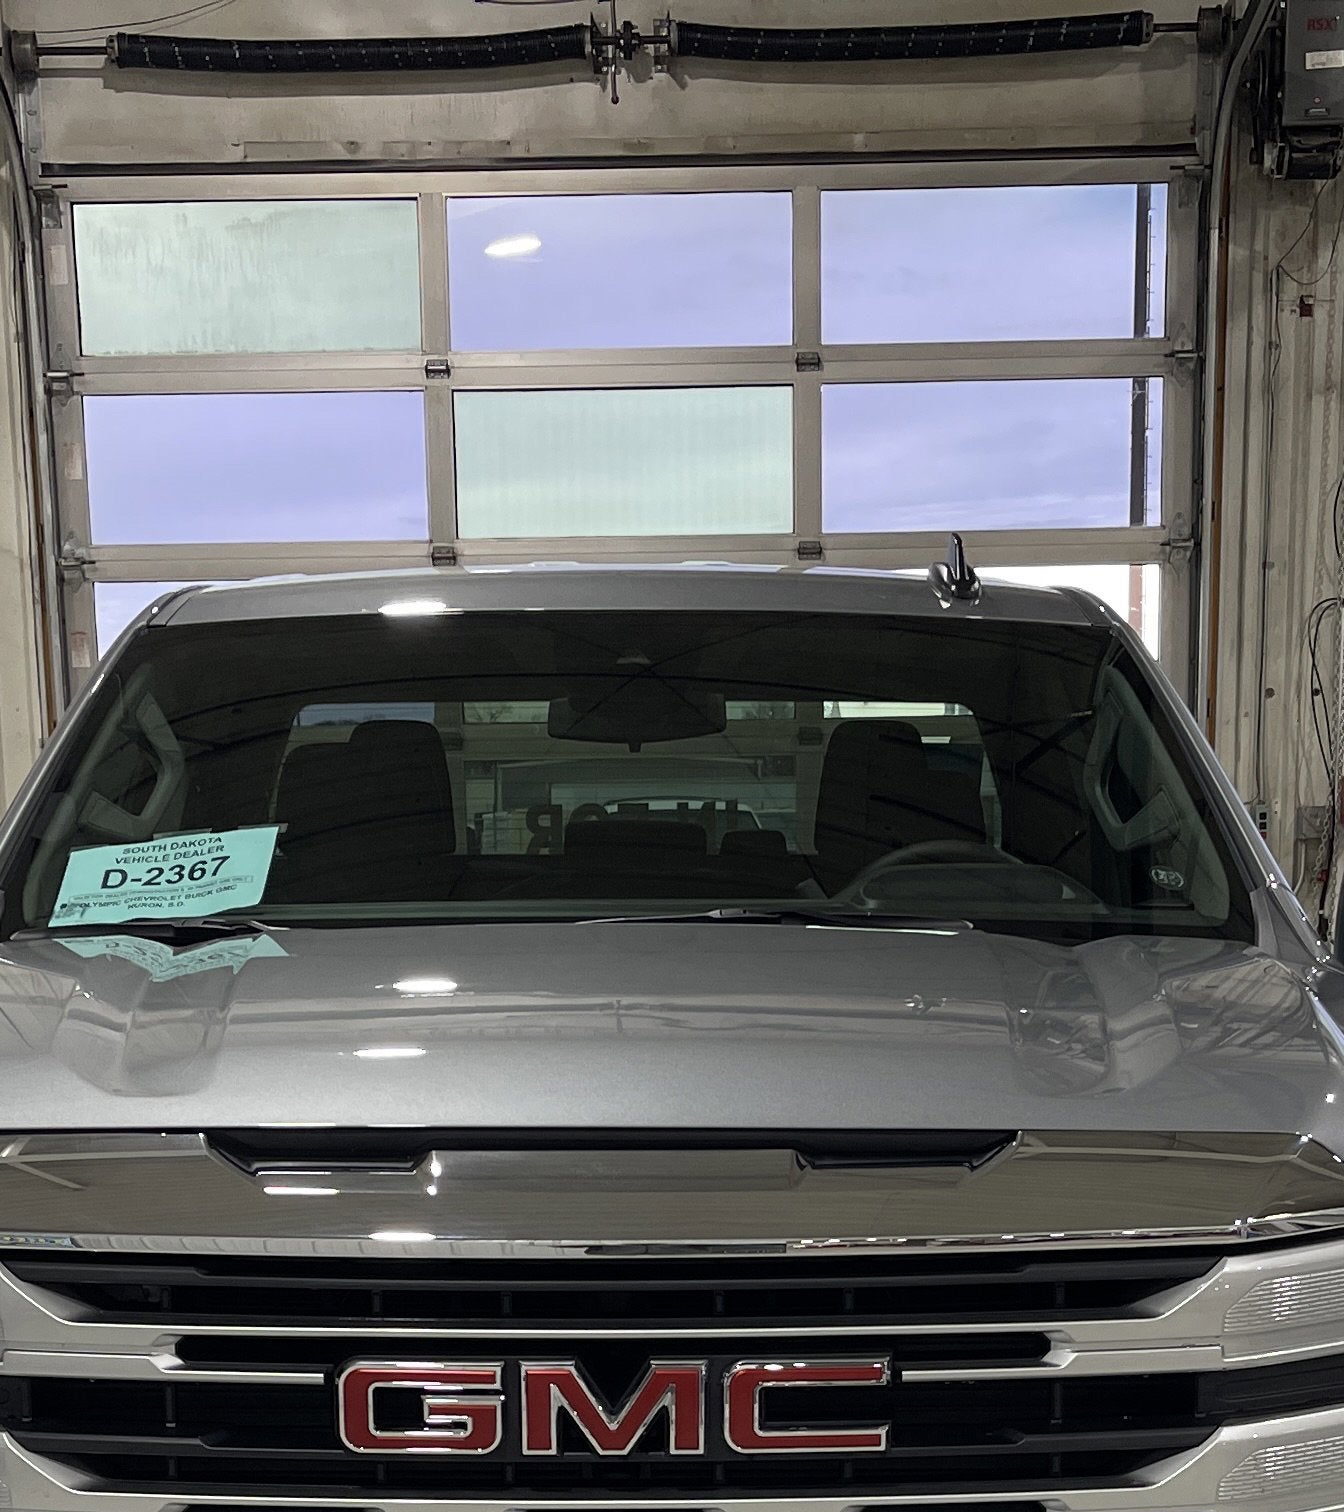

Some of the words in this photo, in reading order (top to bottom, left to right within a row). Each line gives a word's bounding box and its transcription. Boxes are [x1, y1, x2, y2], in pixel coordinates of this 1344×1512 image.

[1307, 18, 1335, 31] RSX
[114, 854, 170, 865] VEHICLE
[173, 844, 225, 861] DEALER
[122, 844, 167, 855] SOUTH
[170, 836, 223, 850] DAKOTA
[101, 855, 231, 890] D-2367
[337, 1358, 890, 1456] GMC
